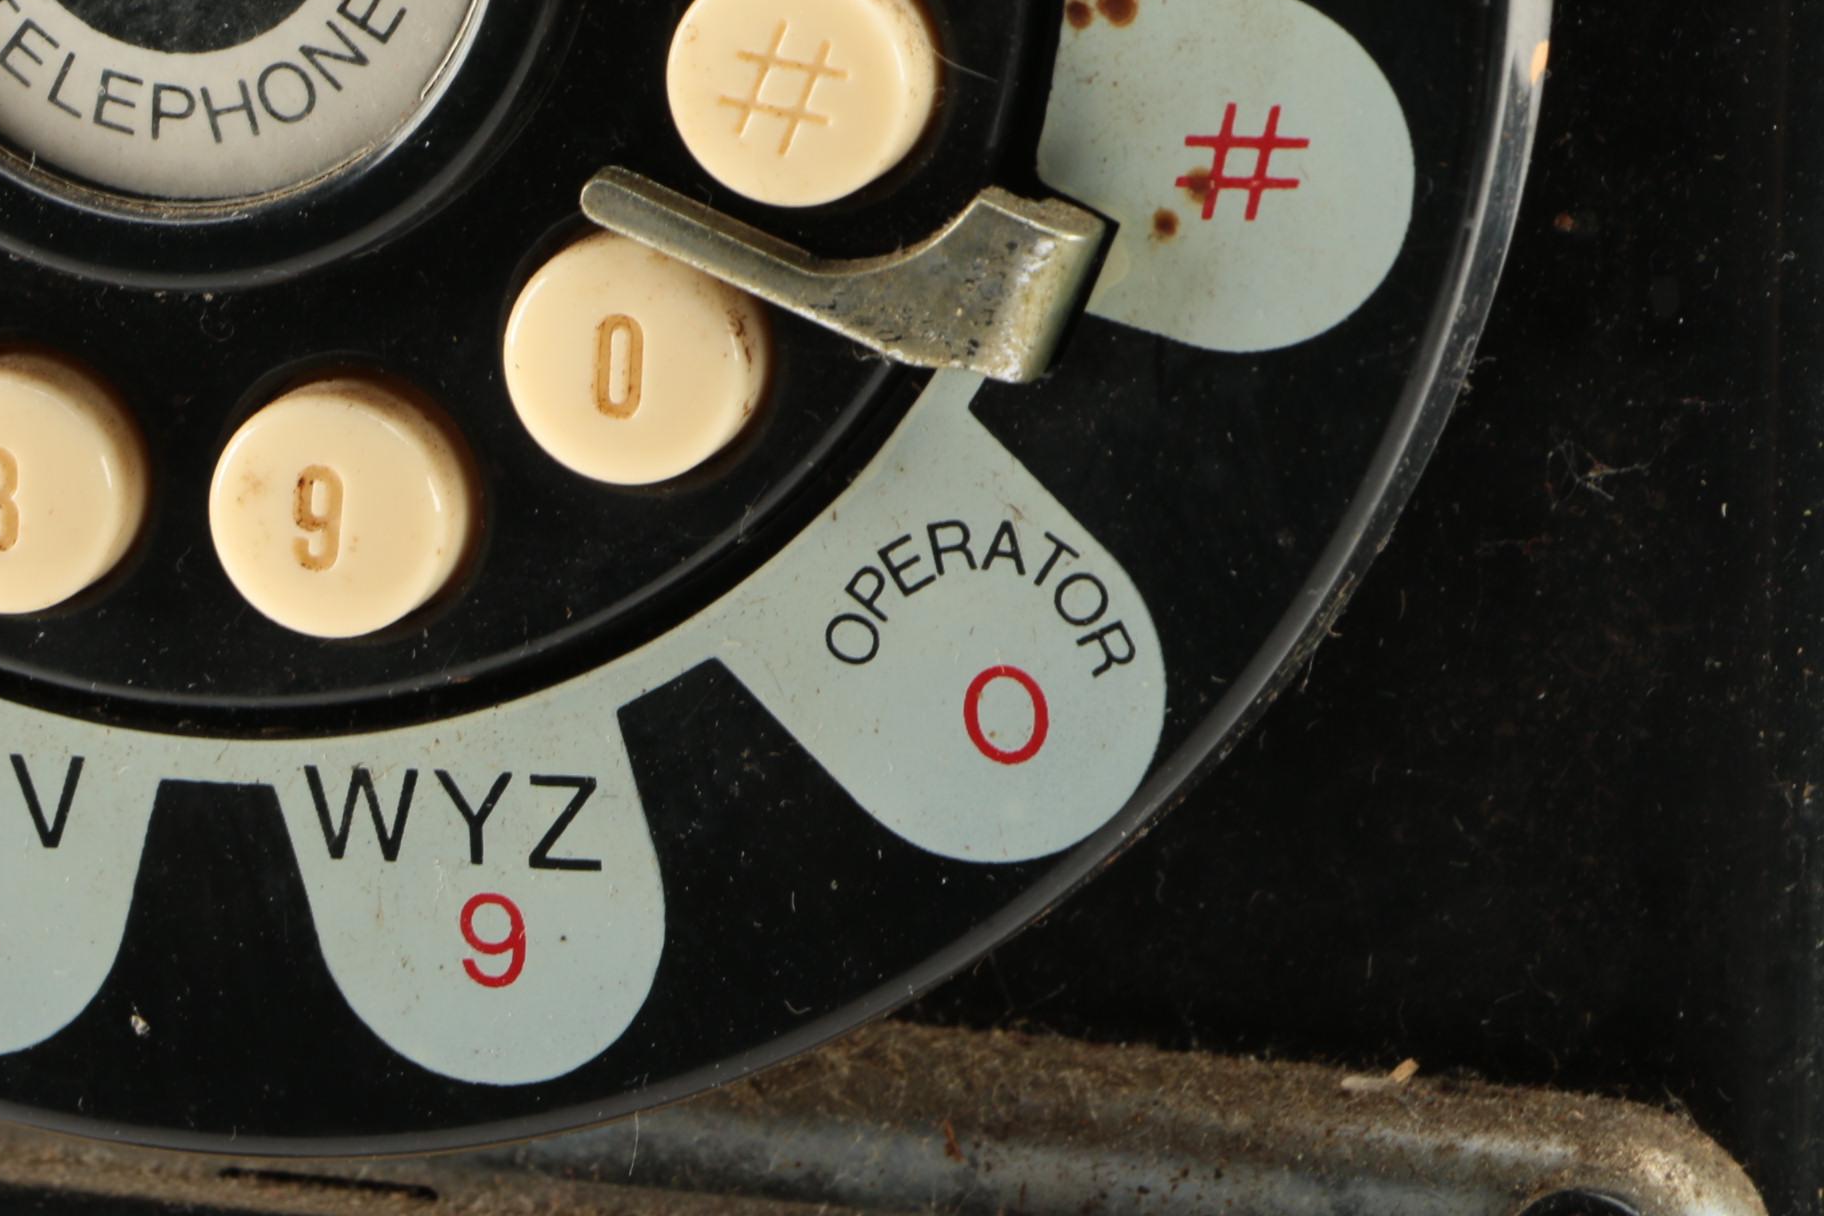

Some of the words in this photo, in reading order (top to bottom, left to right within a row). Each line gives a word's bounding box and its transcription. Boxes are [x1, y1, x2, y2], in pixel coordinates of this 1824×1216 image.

[717, 21, 846, 156] #
[1177, 104, 1308, 220] #
[591, 314, 643, 419] 0
[293, 466, 342, 572] 9
[823, 518, 1137, 677] OPERATOR
[304, 765, 602, 871] WYZ
[461, 894, 526, 987] 9
